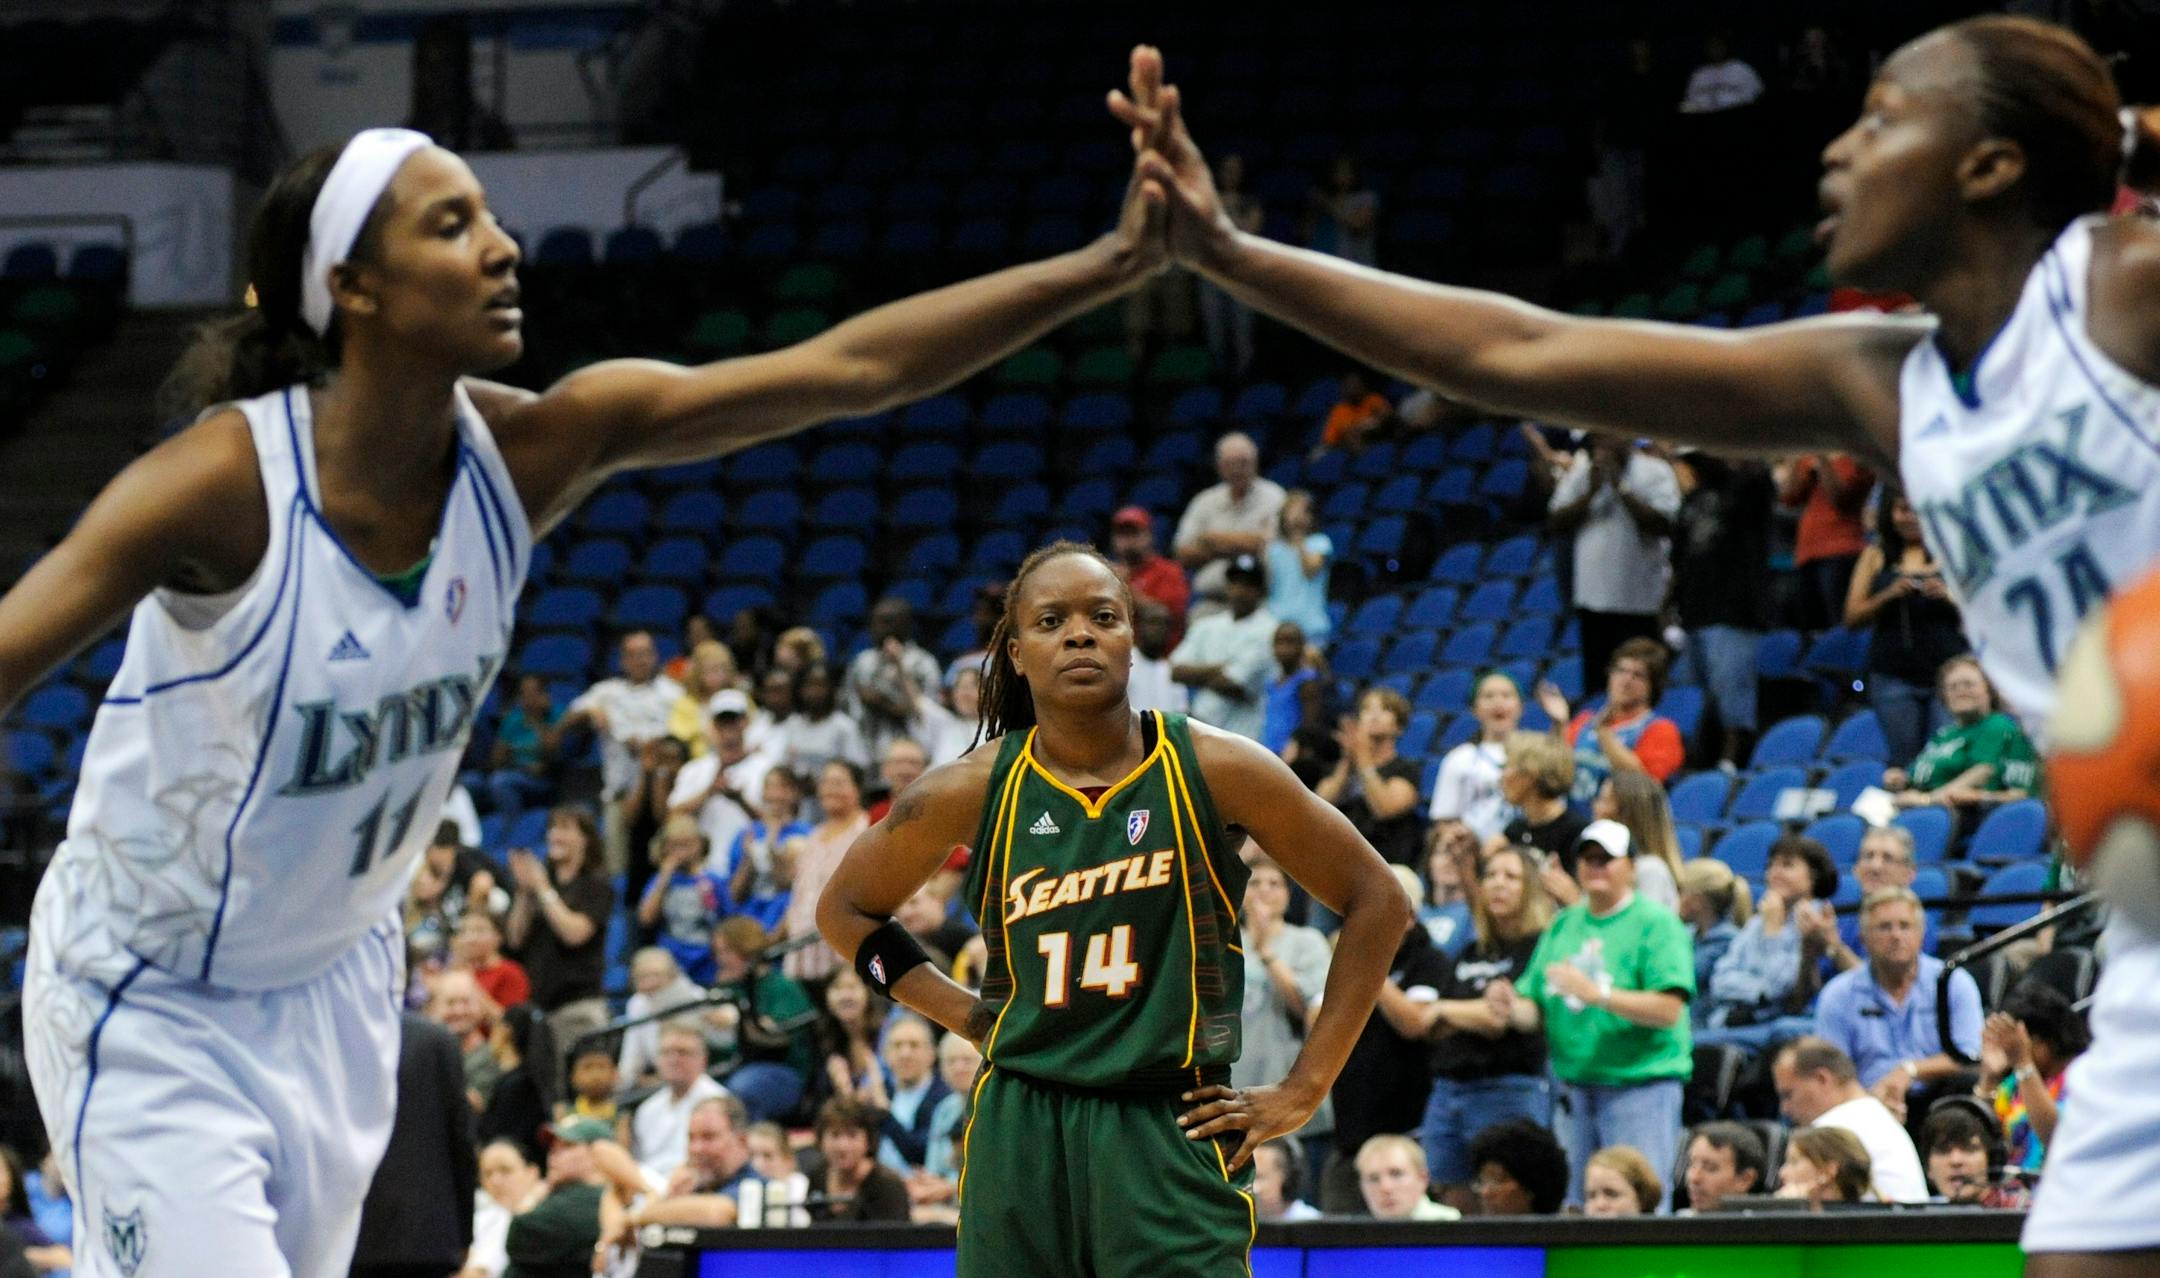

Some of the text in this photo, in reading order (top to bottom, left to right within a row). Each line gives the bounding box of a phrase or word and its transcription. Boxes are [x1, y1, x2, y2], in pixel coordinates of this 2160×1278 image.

[349, 773, 434, 878] 11
[1029, 823, 1061, 835] adidas
[1005, 849, 1175, 925] SEATTLE
[1037, 923, 1143, 1008] 14
